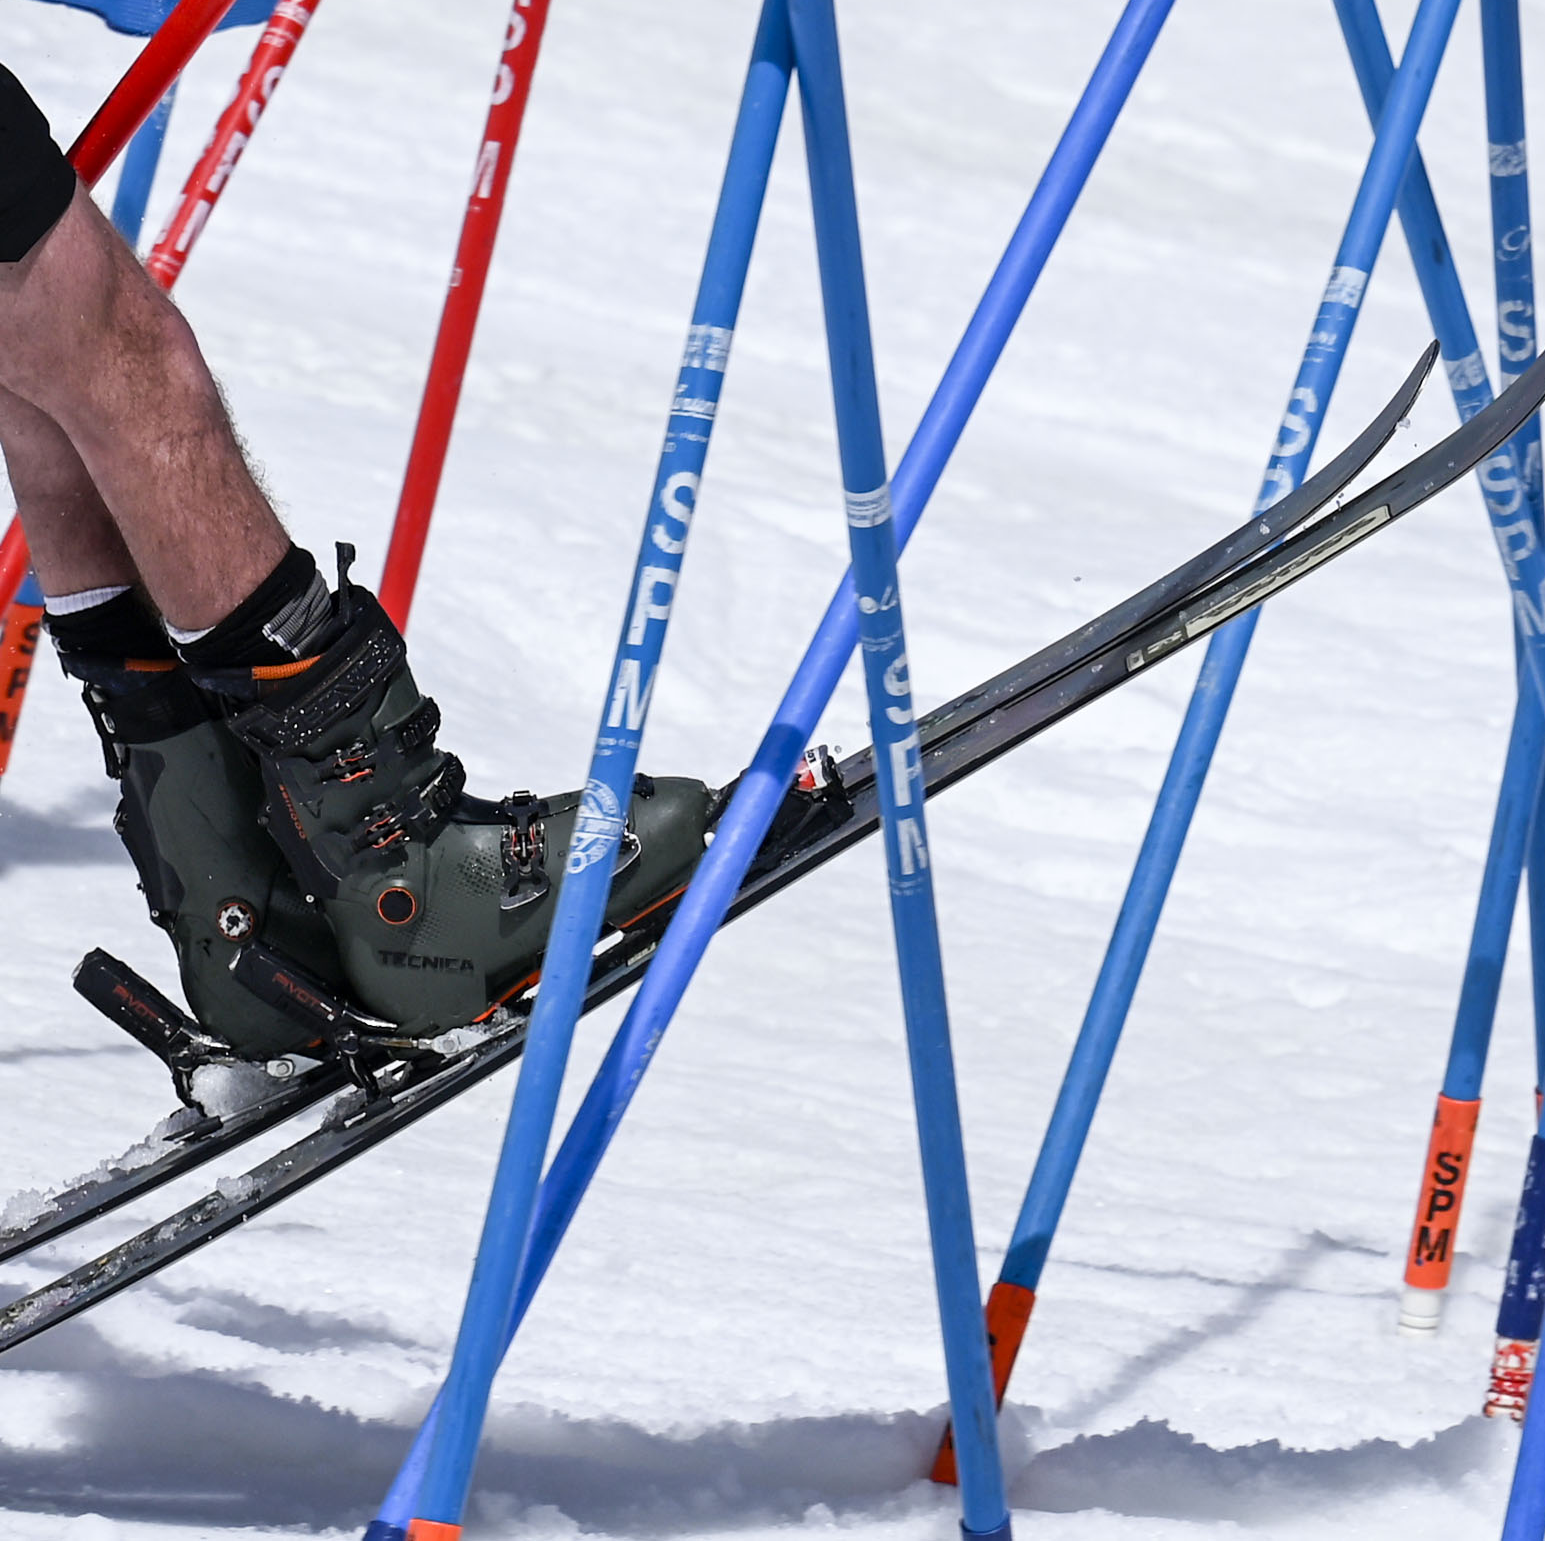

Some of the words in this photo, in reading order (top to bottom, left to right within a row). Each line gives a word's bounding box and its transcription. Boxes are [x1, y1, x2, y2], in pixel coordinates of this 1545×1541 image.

[606, 471, 699, 732] SPM
[377, 950, 476, 973] TECNICA
[1415, 1150, 1462, 1264] SPM
